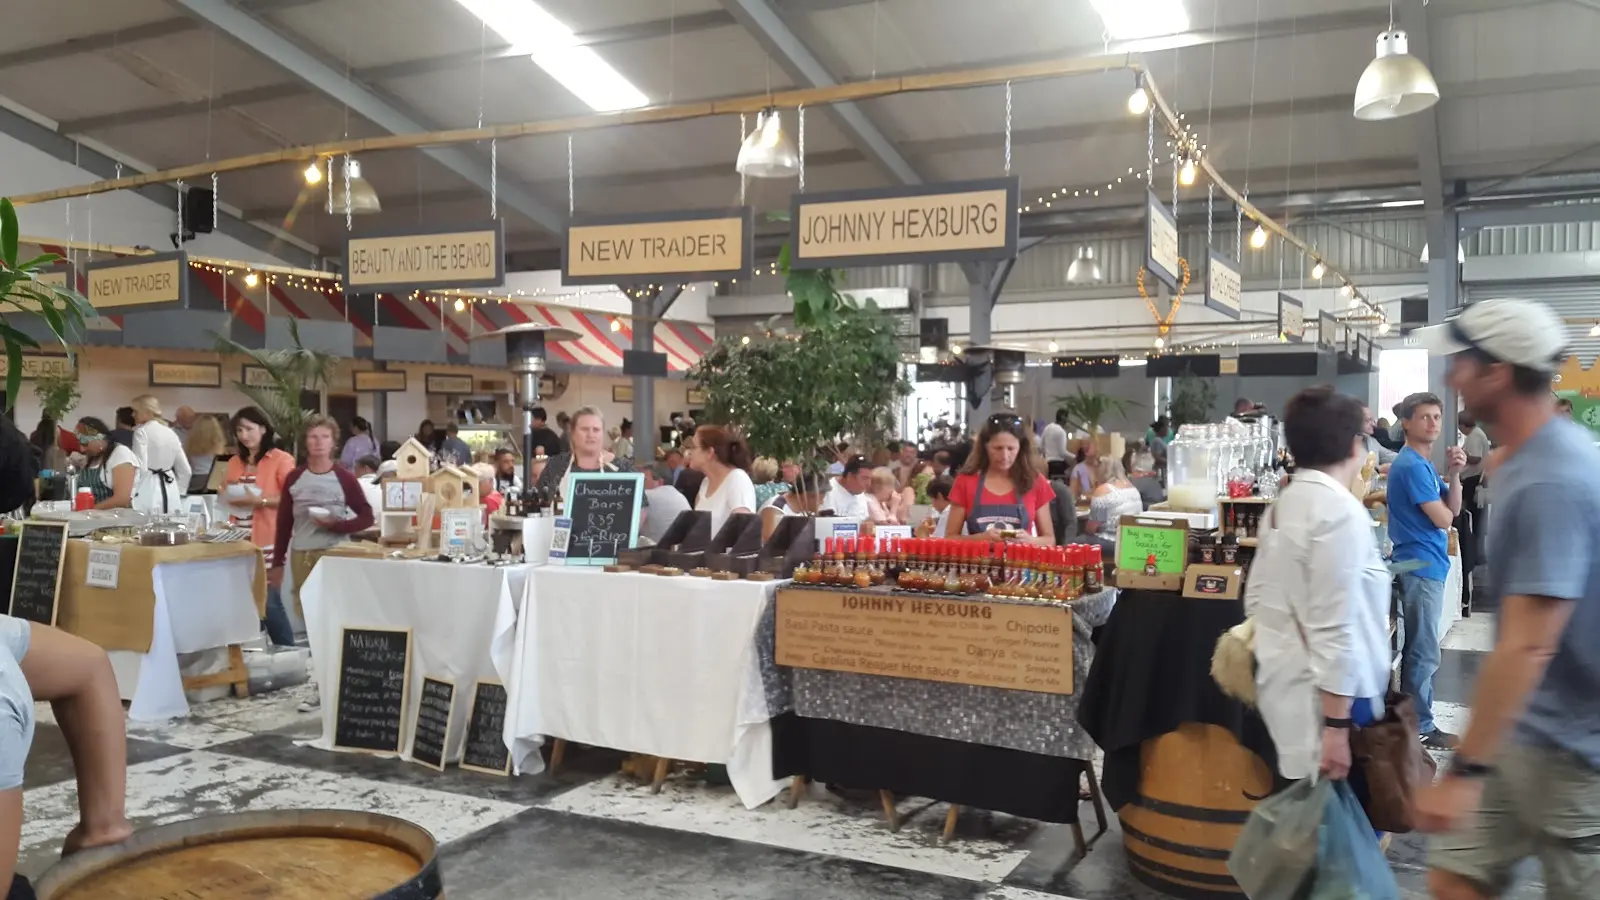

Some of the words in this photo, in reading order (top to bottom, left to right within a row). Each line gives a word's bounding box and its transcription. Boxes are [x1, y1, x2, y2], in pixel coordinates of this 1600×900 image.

[802, 211, 886, 245] JOHNNY
[892, 202, 998, 240] HEXBURG
[352, 247, 397, 274] BEAUTY
[398, 245, 422, 272] AND
[424, 244, 448, 270] THE
[450, 242, 491, 269] BEARD
[580, 238, 634, 262] NEW
[640, 234, 727, 258] TRADER
[93, 278, 121, 297] NEW
[125, 272, 171, 294] TRADER
[575, 483, 632, 496] Chocolate
[589, 497, 623, 510] Bars
[842, 595, 905, 613] JOHNNY
[911, 599, 992, 620] HEXBURG
[784, 618, 808, 630] Basil
[811, 620, 840, 633] Pasta
[843, 625, 874, 636] sauce
[811, 652, 857, 668] Carolina
[902, 662, 923, 674] Hot
[926, 666, 960, 678] sauce
